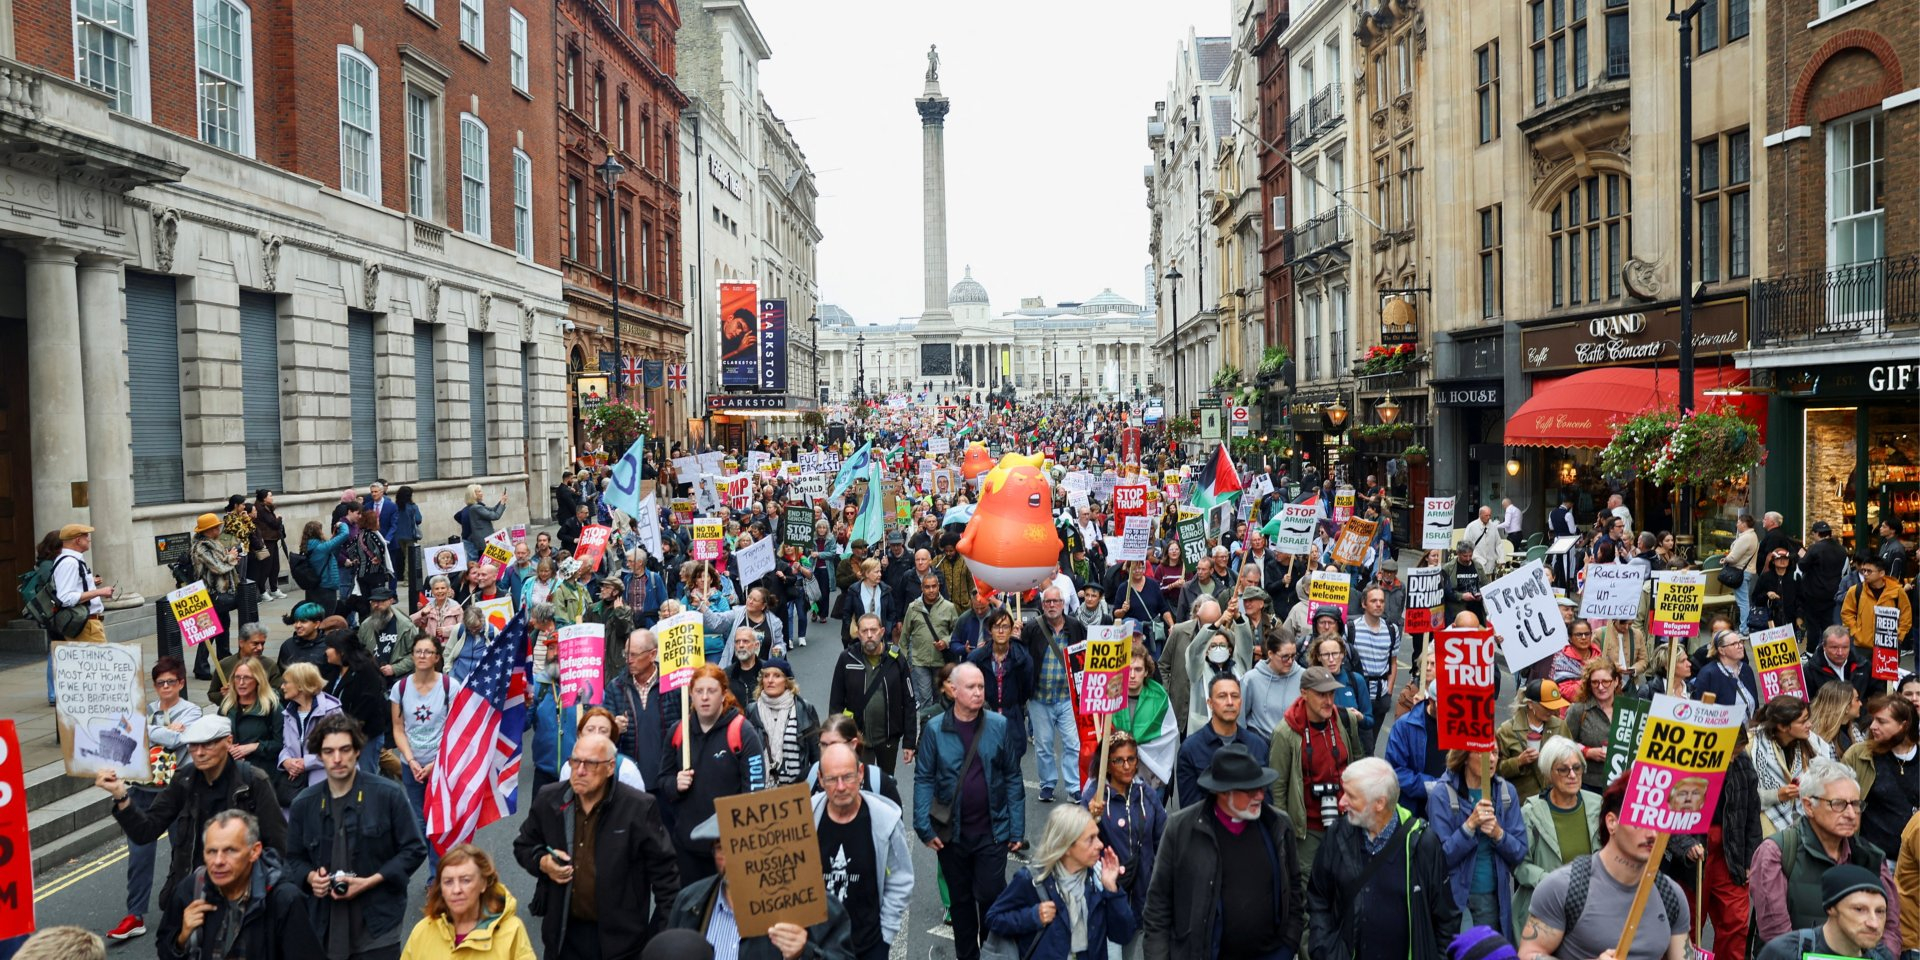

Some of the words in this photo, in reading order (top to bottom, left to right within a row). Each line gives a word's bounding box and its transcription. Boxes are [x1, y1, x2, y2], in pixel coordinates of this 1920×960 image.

[1589, 313, 1645, 339] GRAND
[765, 302, 774, 388] CLARKSTON
[1692, 330, 1738, 348] istorante
[1606, 338, 1661, 361] Concerto
[712, 399, 784, 407] CLARKSTON
[1450, 389, 1497, 403] HOUSE
[1556, 414, 1592, 430] Concerto
[1116, 488, 1144, 500] STOP
[1117, 498, 1144, 509] TRUMP
[1286, 507, 1316, 517] STOP
[1284, 516, 1314, 524] ARMING
[583, 527, 607, 538] STOP
[787, 524, 812, 534] STOP
[1180, 523, 1195, 534] END
[787, 532, 812, 542] TRUMP
[1280, 536, 1310, 545] ISRAEL
[1345, 530, 1370, 543] TRUMP
[489, 545, 498, 553] NO
[498, 548, 506, 556] TO
[696, 540, 706, 548] NO
[1184, 539, 1206, 555] STO
[1339, 539, 1367, 555] NOT
[486, 549, 508, 562] RACISM
[696, 551, 719, 560] TRUMP
[1185, 551, 1207, 565] TRU
[1593, 565, 1640, 579] Racism
[1312, 581, 1348, 592] Refugees
[1409, 574, 1441, 592] DUMP
[1670, 584, 1696, 594] STOP
[1312, 591, 1346, 601] welcome
[1485, 567, 1548, 614] TRUMP
[174, 599, 188, 610] NO
[188, 595, 199, 605] TO
[1408, 588, 1444, 608] TRUMP
[1663, 593, 1698, 603] RACIST
[177, 600, 208, 618] RACISM
[1585, 603, 1637, 616] CIVILISED
[1660, 602, 1699, 612] REFORM
[1408, 611, 1424, 619] Fight
[1672, 612, 1686, 621] UK
[181, 617, 196, 629] NO
[1663, 622, 1691, 630] Refugees
[1876, 616, 1899, 630] FREED
[184, 626, 198, 636] TO
[188, 625, 217, 644] TRUMP
[668, 624, 695, 639] STOP
[664, 634, 699, 651] RACIST
[1874, 633, 1898, 648] PALEST
[58, 648, 79, 661] ONE
[81, 649, 114, 661] THINKS
[663, 645, 702, 662] REFORM
[1091, 644, 1110, 656] NO
[1114, 642, 1125, 655] TO
[1444, 636, 1495, 666] STO
[1757, 645, 1771, 659] NO
[1773, 642, 1788, 655] TO
[78, 661, 110, 671] YOU'LL
[113, 663, 133, 671] FEEL
[560, 656, 602, 670] Refugees
[675, 656, 690, 668] UK
[1090, 652, 1127, 669] RACISM
[1760, 651, 1797, 670] RACISM
[58, 669, 82, 680] MOST
[86, 672, 97, 680] AT
[101, 673, 128, 681] HOME
[560, 668, 600, 682] welcome
[669, 669, 695, 680] Refuge
[1087, 673, 1107, 686] NO
[1444, 663, 1495, 687] TRU
[1762, 671, 1779, 685] NO
[58, 681, 66, 690] IF
[67, 682, 79, 691] WE
[82, 683, 98, 691] PUT
[100, 683, 116, 691] YOU
[117, 683, 126, 691] IN
[560, 682, 578, 695] here
[1086, 685, 1104, 698] TO
[1765, 682, 1780, 696] TO
[67, 705, 86, 714] OLD
[88, 705, 129, 714] BEDROOM
[1084, 695, 1123, 713] TRUMP
[1695, 707, 1719, 717] STAND
[1719, 710, 1729, 718] UP
[1446, 720, 1495, 739] FASC
[1652, 722, 1686, 744] NO
[1693, 730, 1718, 750] TO
[1646, 741, 1725, 769] RACISM
[748, 755, 763, 790] HOLL
[1638, 766, 1673, 789] NO
[1636, 784, 1665, 808] TO
[731, 797, 805, 828] RAPIST
[1630, 803, 1702, 831] TRUMP
[730, 823, 811, 854] PAEDOPHILE
[745, 850, 806, 875] RUSSIAN
[759, 865, 797, 889] ASSET
[749, 887, 818, 916] DISGRACE
